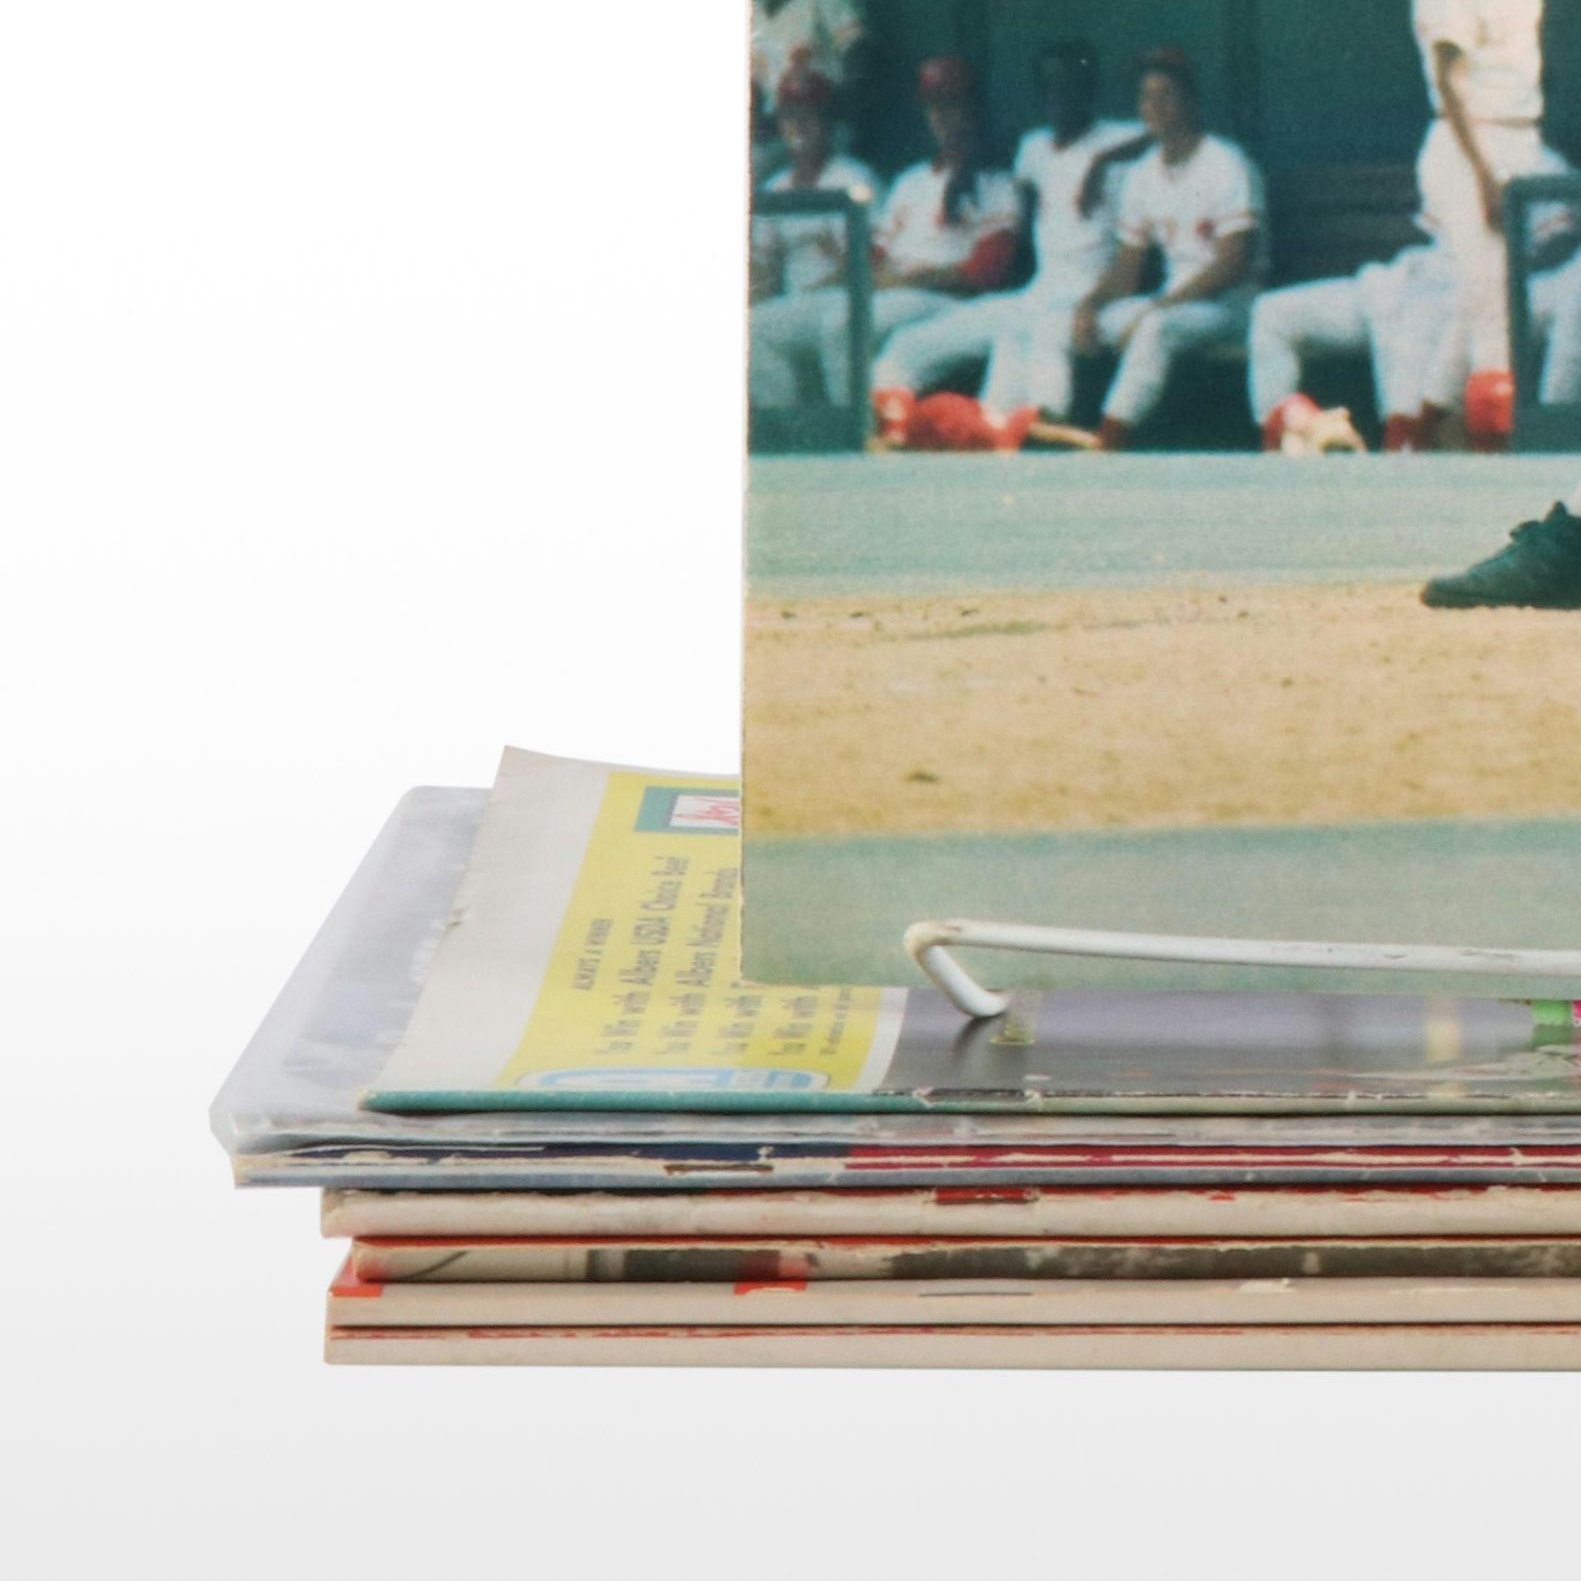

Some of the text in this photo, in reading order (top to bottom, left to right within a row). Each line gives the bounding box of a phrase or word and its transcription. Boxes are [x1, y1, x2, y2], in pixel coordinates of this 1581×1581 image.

[640, 879, 683, 910] Choice
[630, 916, 671, 946] USDA
[685, 901, 730, 947] National
